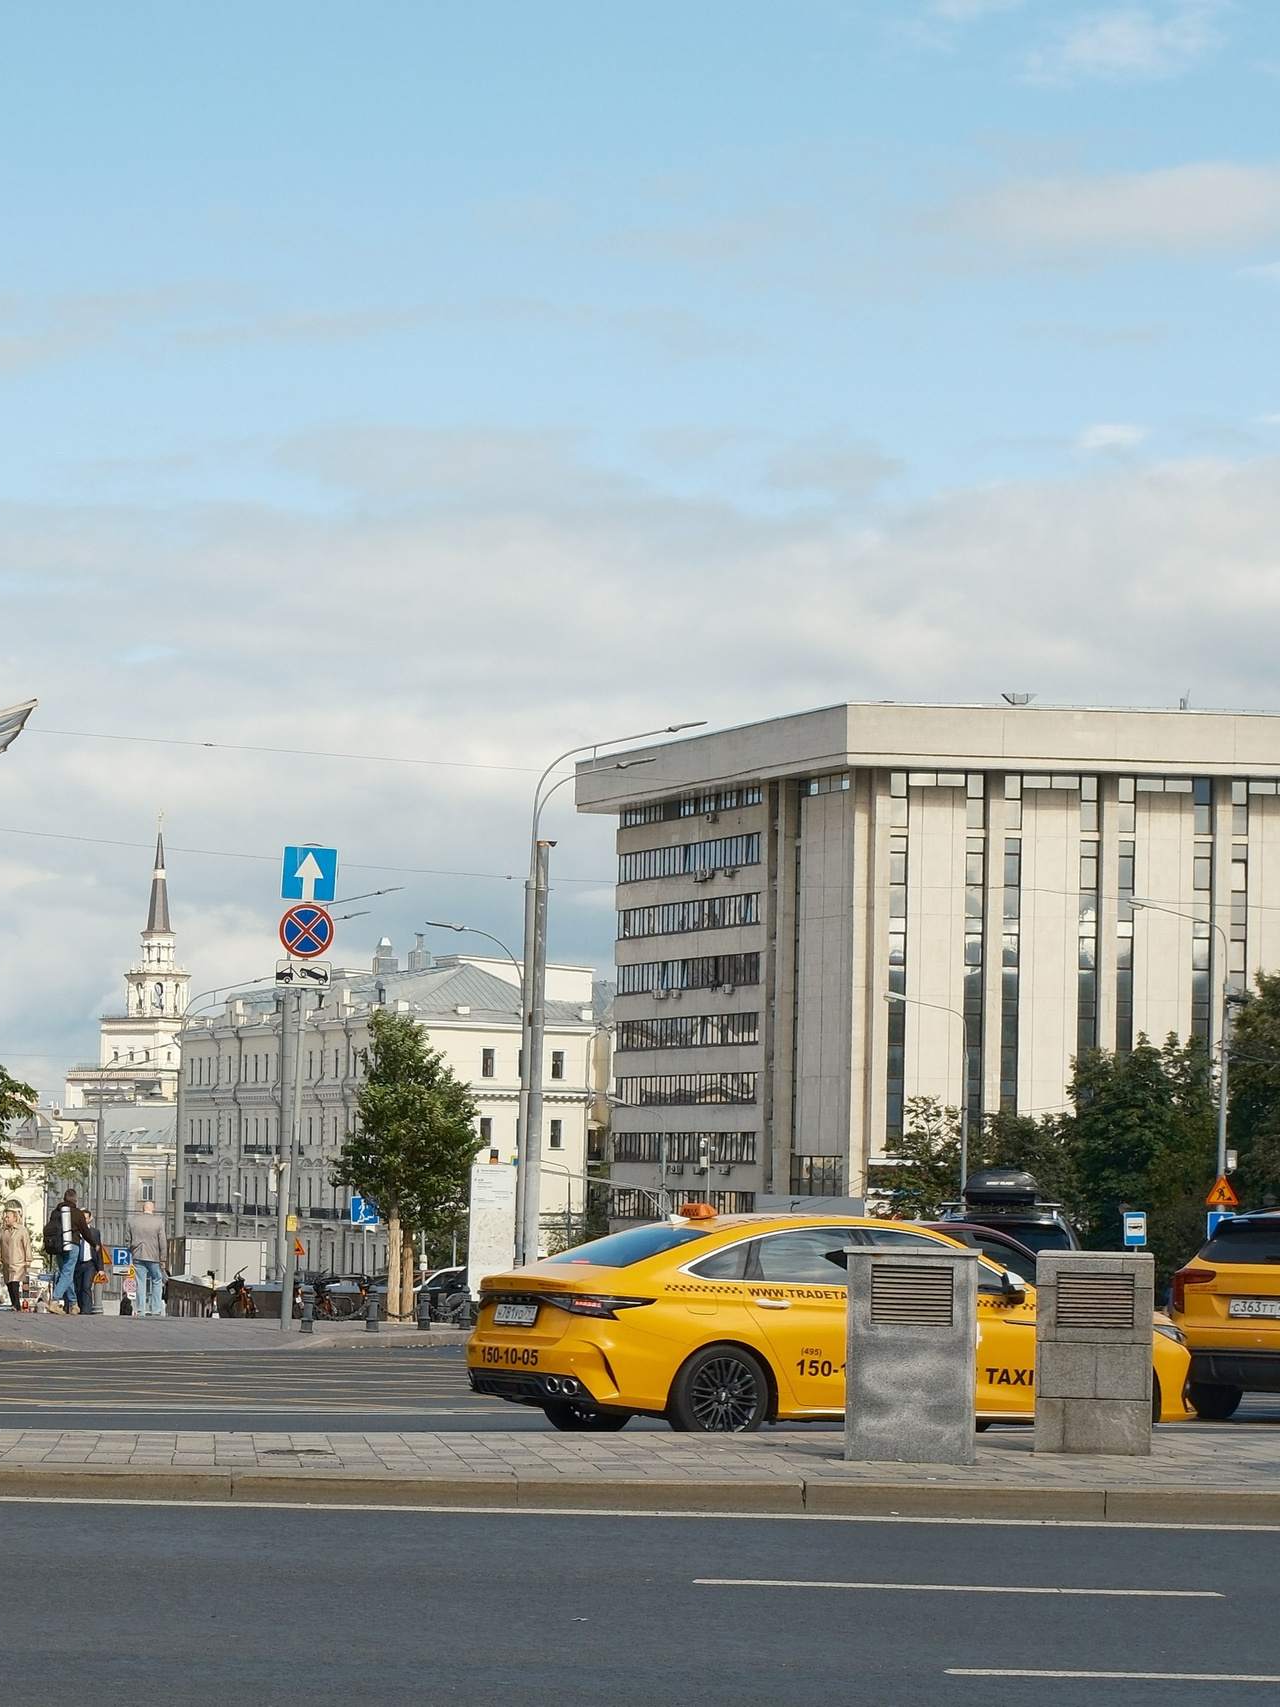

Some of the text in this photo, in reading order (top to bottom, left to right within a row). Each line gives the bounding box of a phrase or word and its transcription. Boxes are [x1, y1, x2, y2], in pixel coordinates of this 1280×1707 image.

[117, 1249, 128, 1265] P
[481, 1346, 539, 1367] 150-10-05
[801, 1347, 822, 1358] (495)
[985, 1368, 1034, 1386] TAXI
